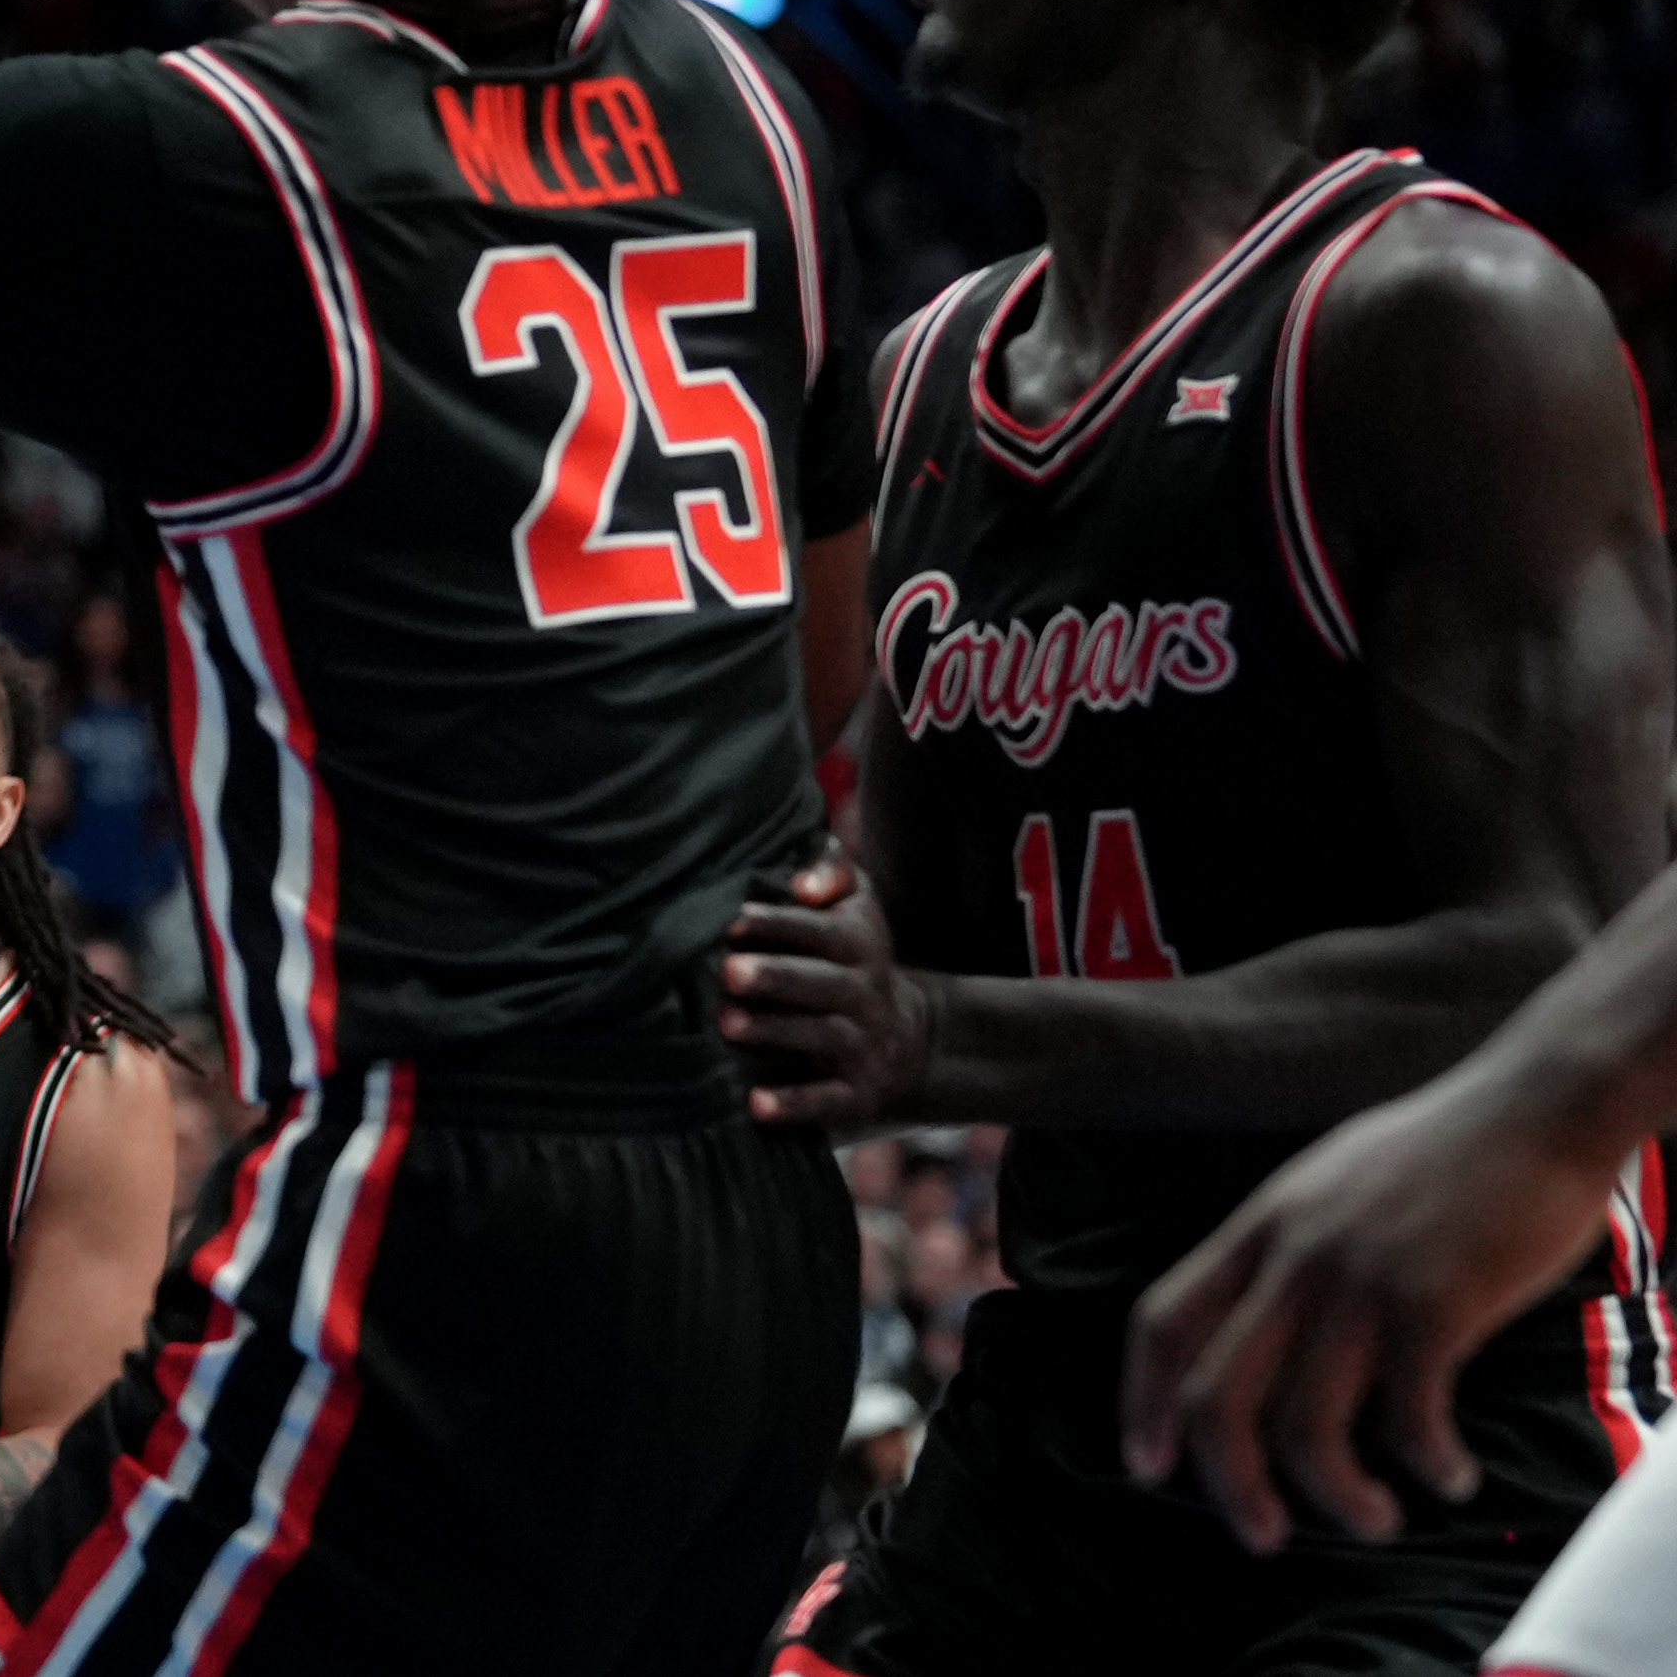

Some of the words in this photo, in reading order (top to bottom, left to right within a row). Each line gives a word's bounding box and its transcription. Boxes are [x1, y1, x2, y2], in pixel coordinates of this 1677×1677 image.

[432, 74, 682, 208] MILLER
[459, 228, 792, 630] 25
[875, 569, 1239, 769] Cougars
